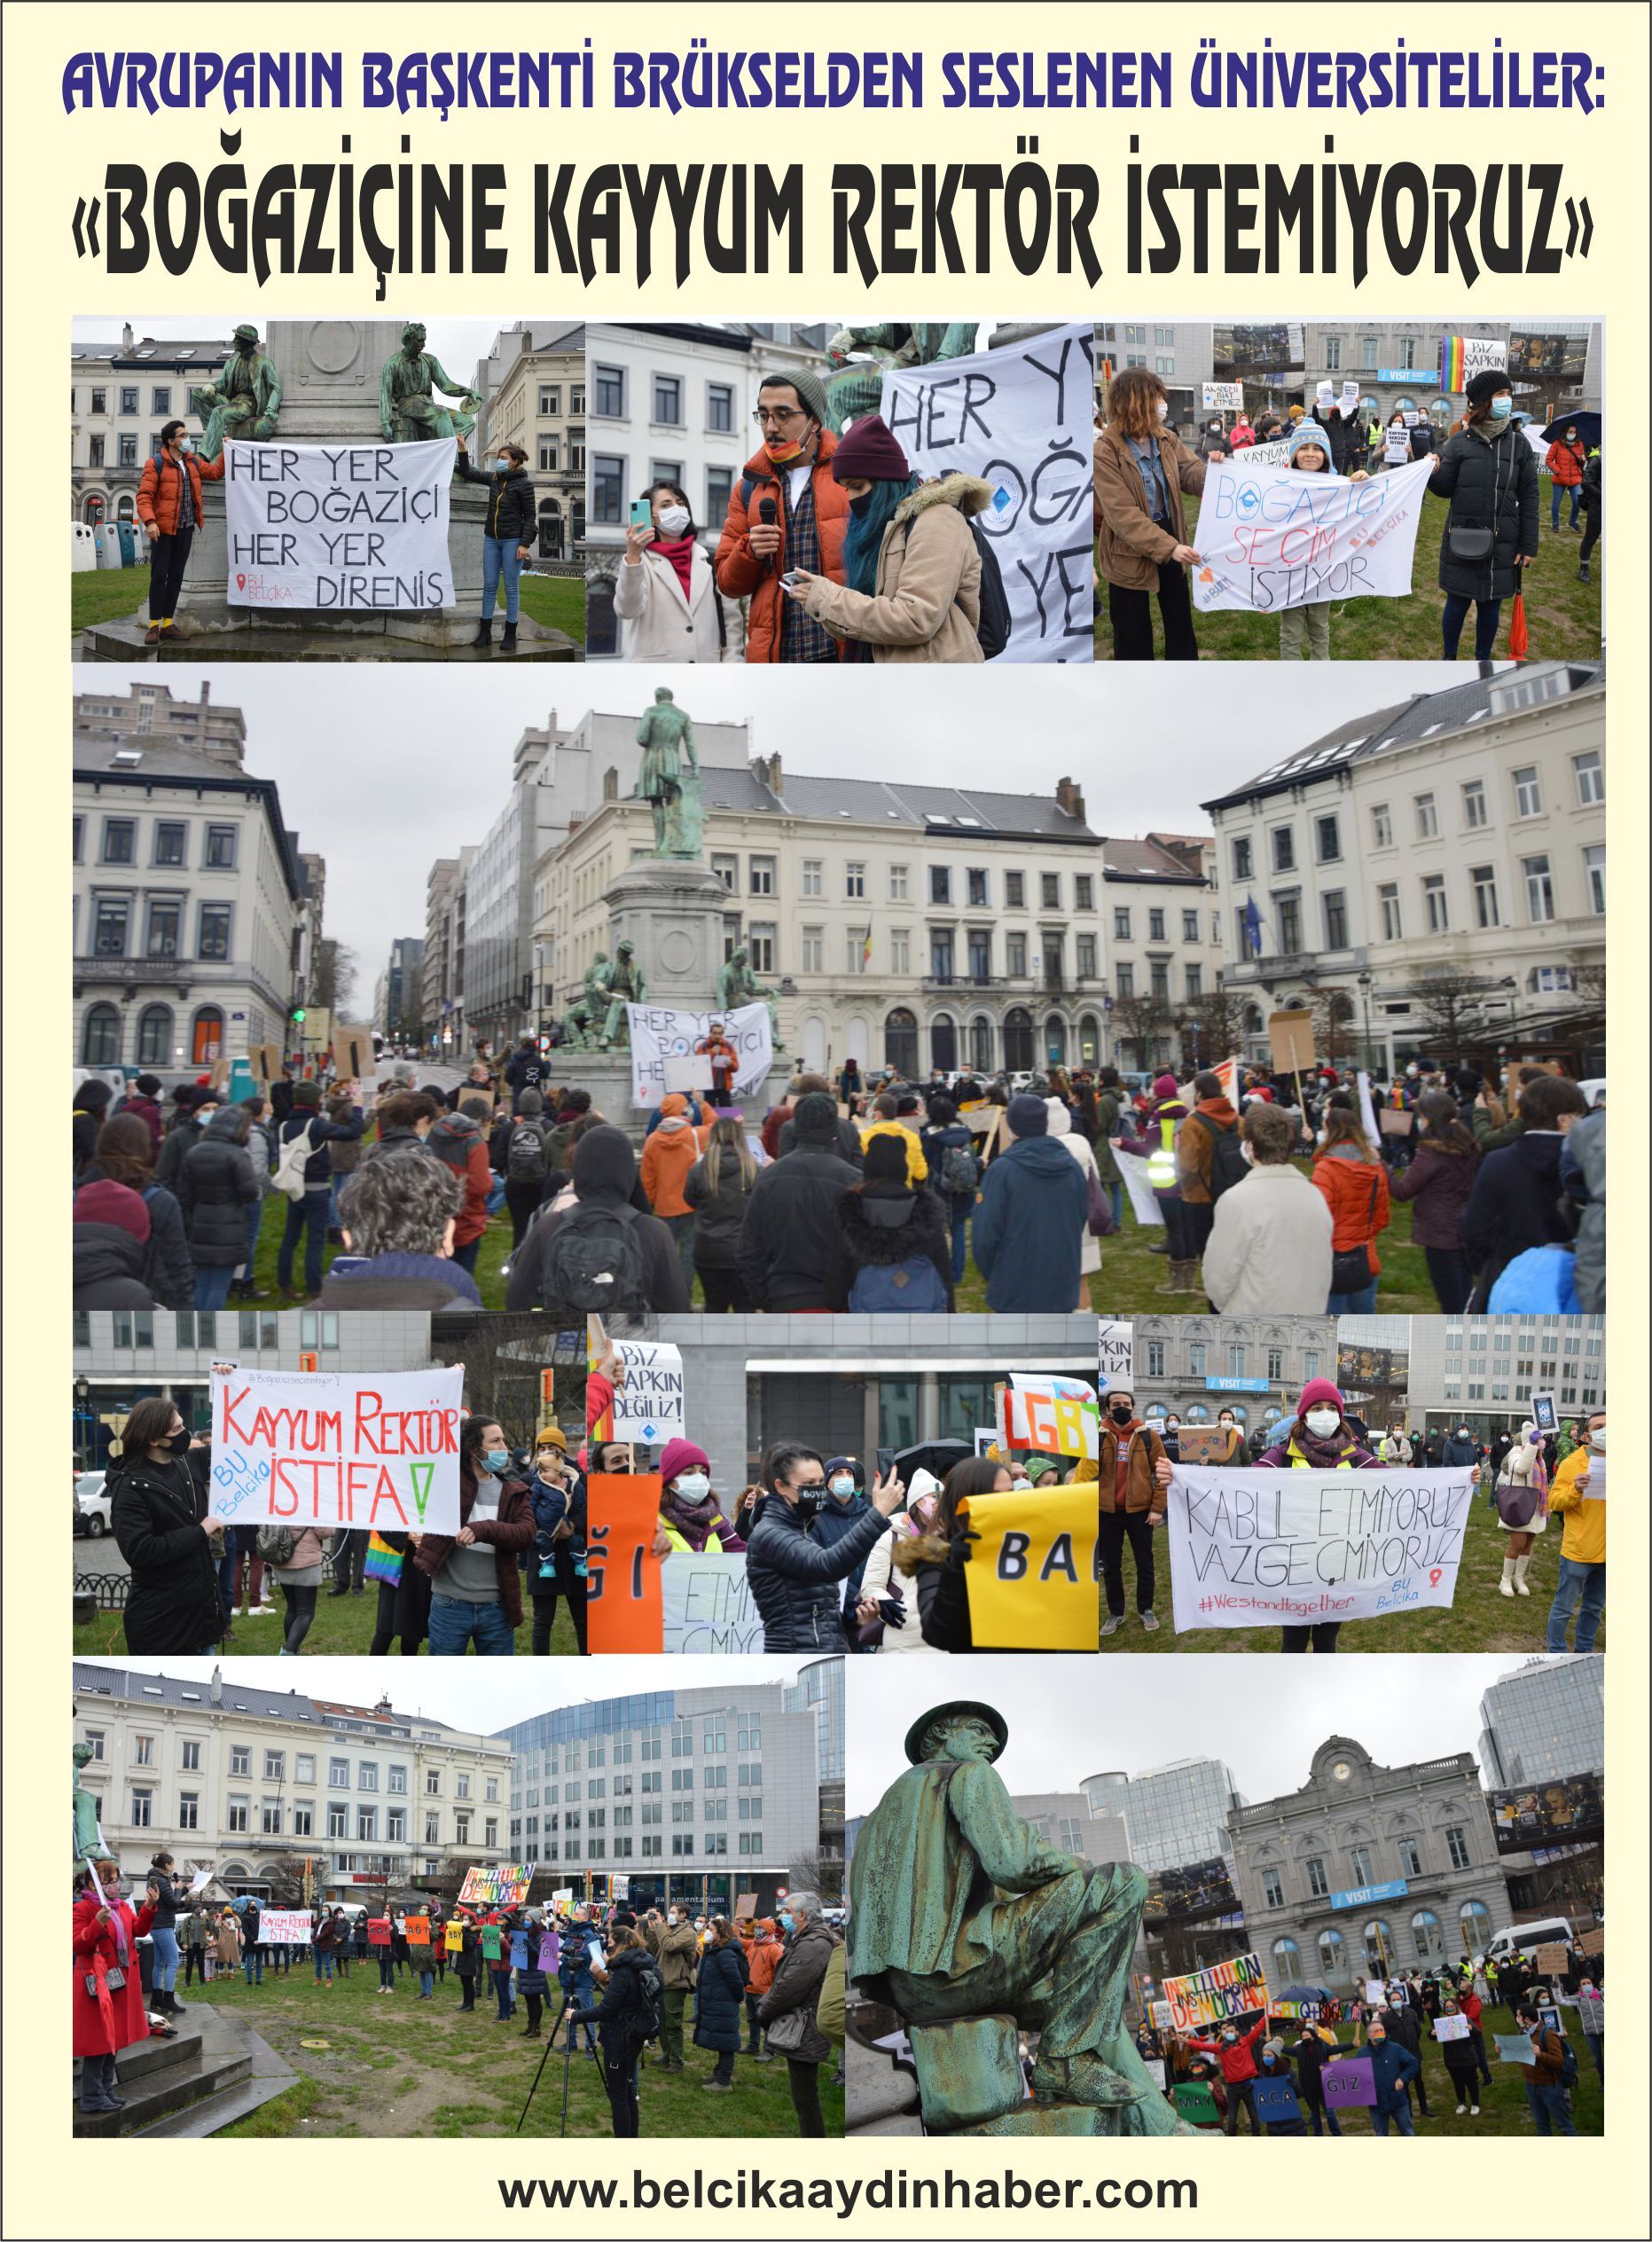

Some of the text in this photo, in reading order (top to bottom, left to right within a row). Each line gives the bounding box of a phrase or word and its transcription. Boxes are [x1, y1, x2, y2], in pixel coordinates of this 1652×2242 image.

[889, 373, 997, 452] HER
[231, 449, 399, 482] HER YER
[233, 533, 386, 567] HER YER
[1225, 526, 1337, 568] SEÇİM
[1249, 556, 1374, 608] İSTİYOR
[632, 1009, 676, 1031] HER
[620, 1344, 664, 1367] BİZ
[614, 1369, 683, 1393] APKIN
[1219, 1379, 1241, 1388] VISIT
[223, 1385, 459, 1455] KAYYUM REKTÖR
[213, 1449, 248, 1487] BU
[1186, 1486, 1467, 1540] KABUL ETMİYORUZ
[1188, 1528, 1460, 1587] VAZGEÇMİYORUZ
[1391, 1577, 1411, 1593] BU
[1198, 1595, 1356, 1617] #Westandtogether
[1345, 1888, 1372, 1904] VISIT
[1178, 2096, 1212, 2109] MAY
[1257, 2090, 1295, 2106] ACA
